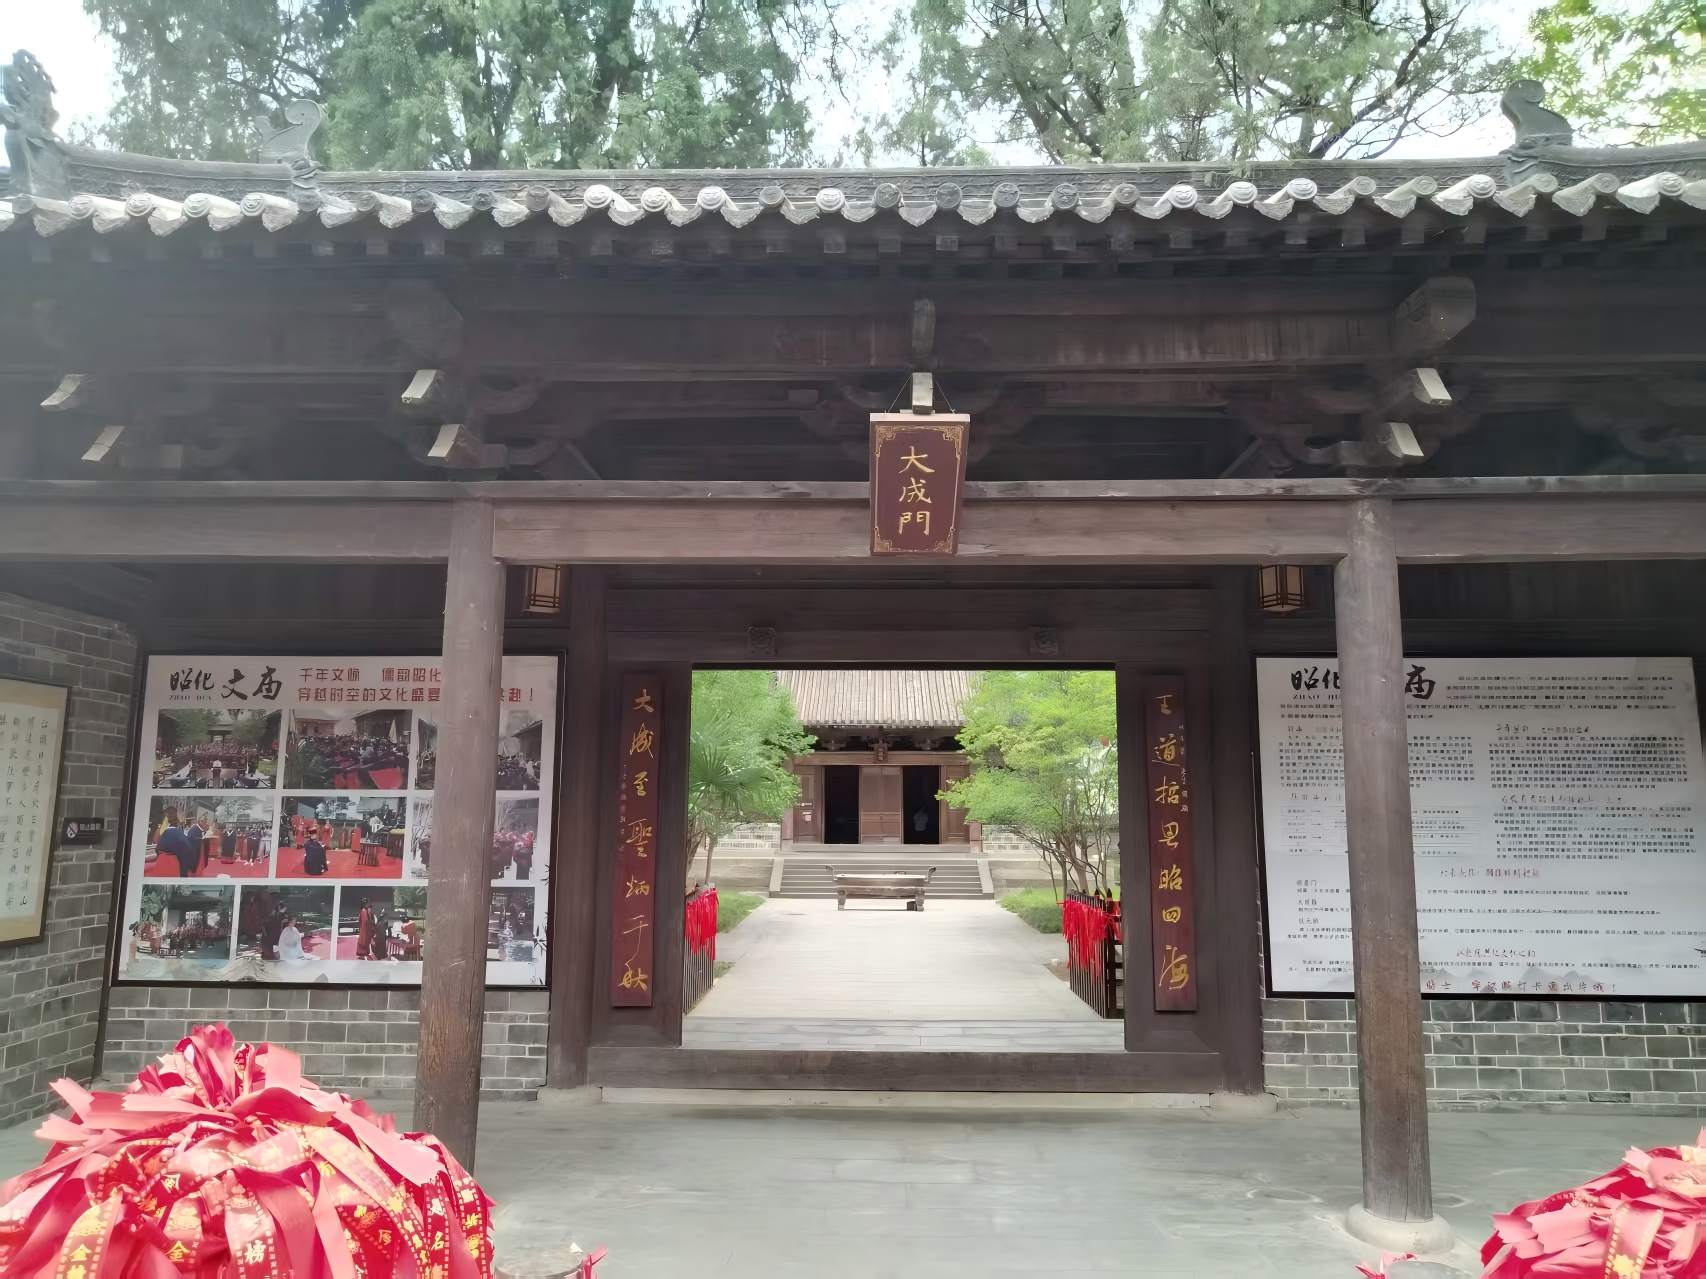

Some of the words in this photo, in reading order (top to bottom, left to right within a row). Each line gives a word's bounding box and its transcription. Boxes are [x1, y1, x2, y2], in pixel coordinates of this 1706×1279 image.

[898, 445, 936, 536] 大成門
[299, 667, 361, 682] 千年文脉
[297, 687, 442, 703] 穿越时空的文化盛宴
